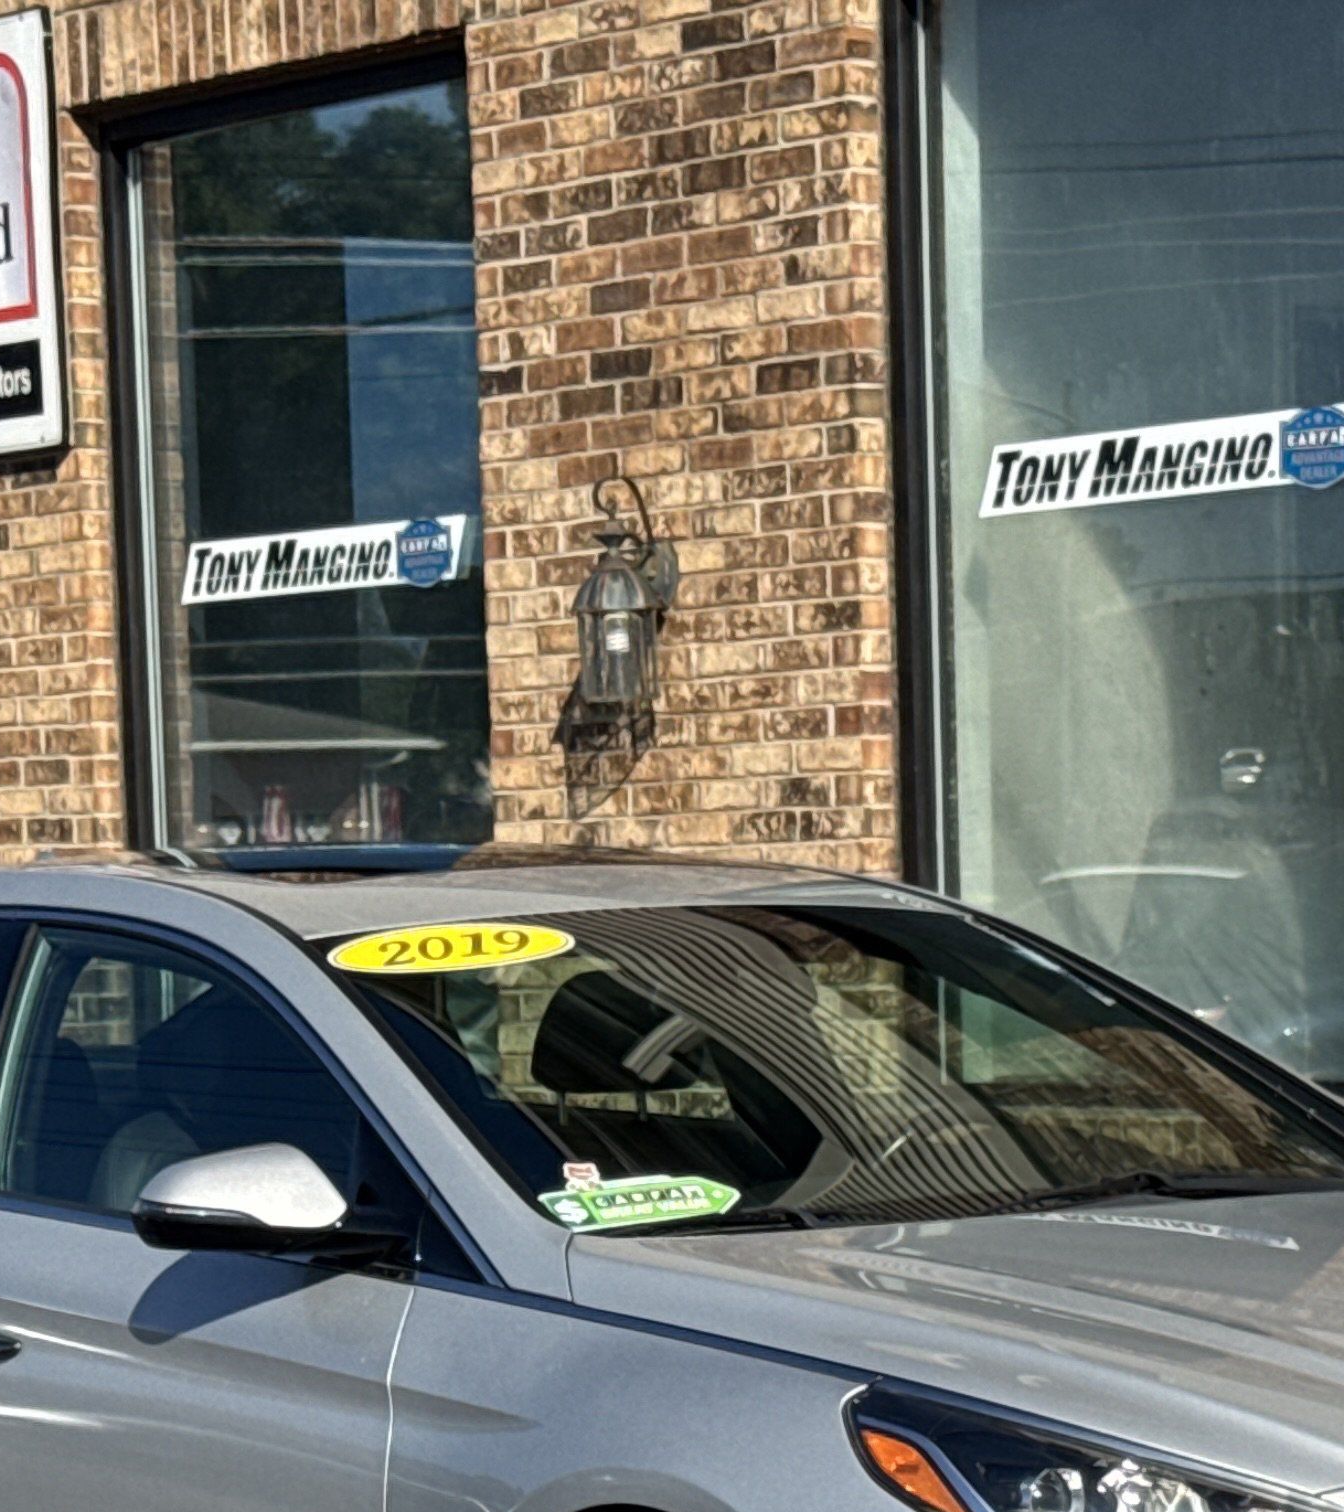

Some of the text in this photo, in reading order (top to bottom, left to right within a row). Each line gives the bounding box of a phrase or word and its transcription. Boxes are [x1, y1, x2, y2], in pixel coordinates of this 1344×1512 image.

[993, 432, 1273, 508] TONY MANGINO
[192, 547, 262, 596] TONY
[261, 538, 392, 591] MANGINO
[377, 928, 530, 966] 2019
